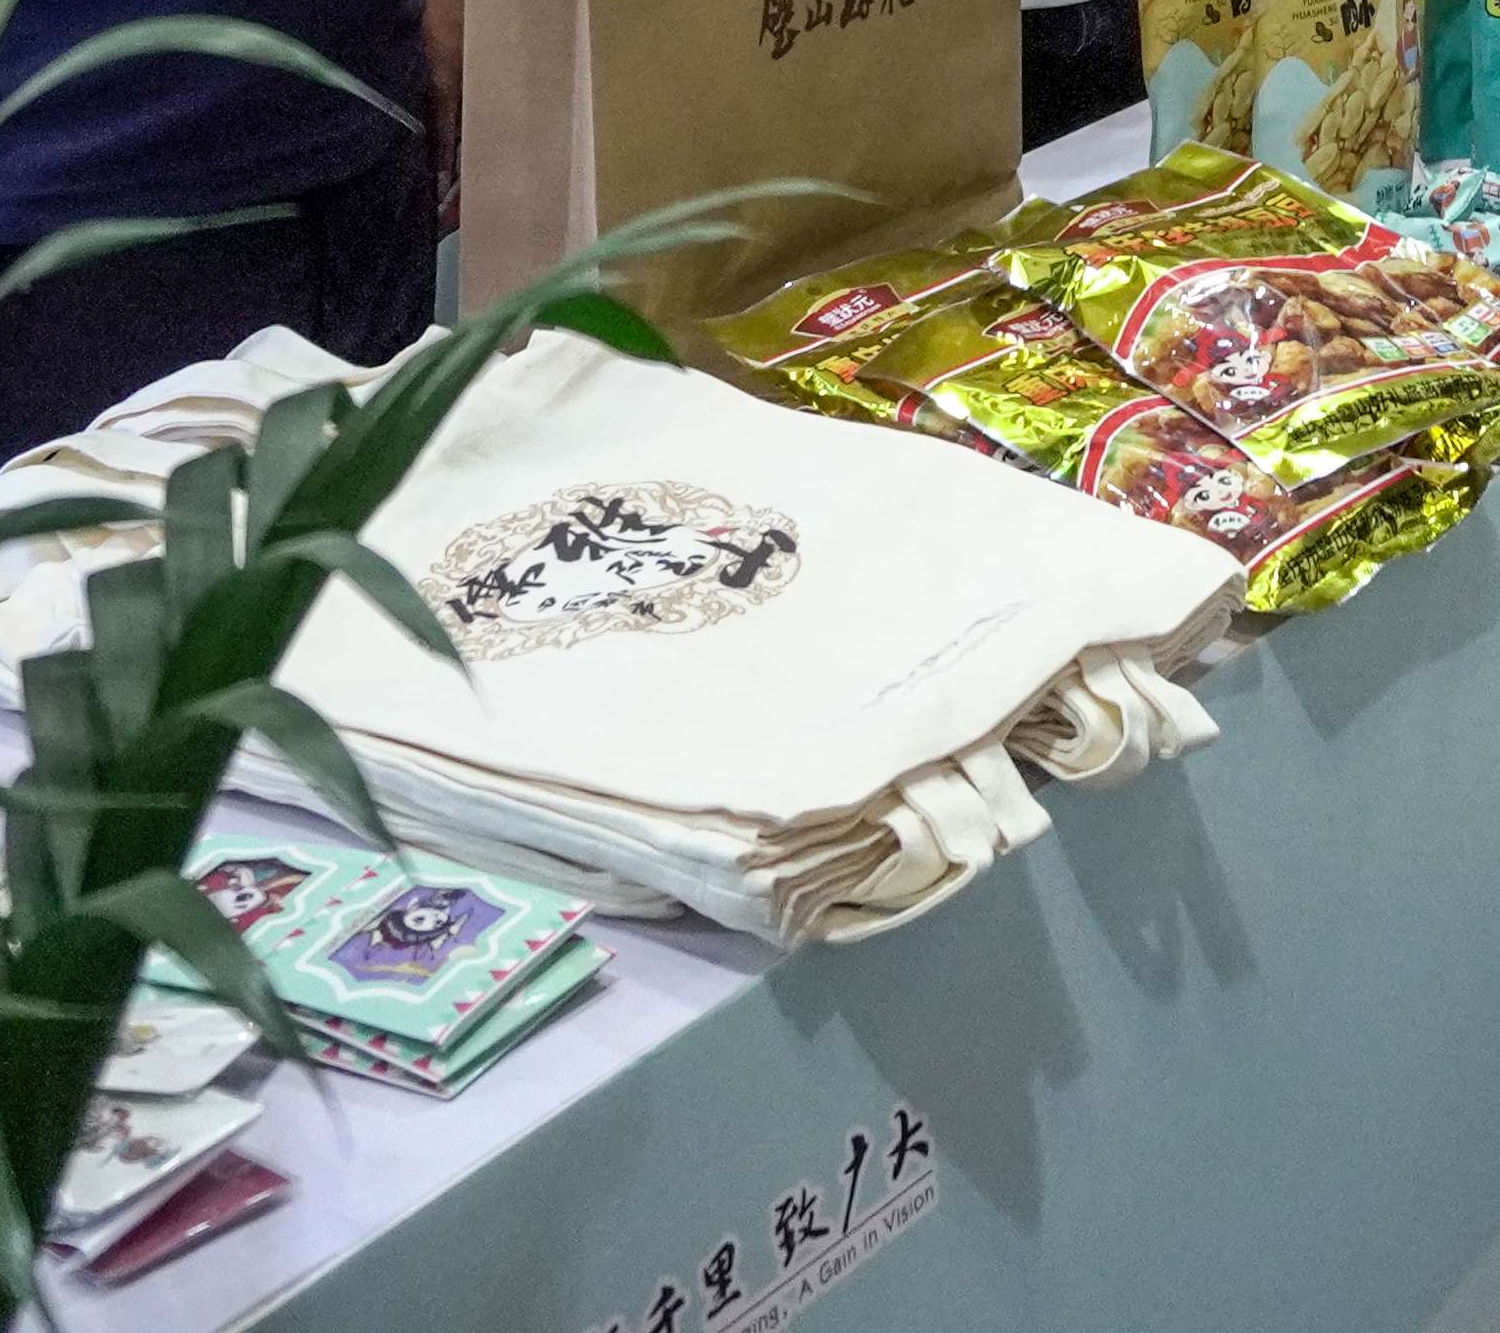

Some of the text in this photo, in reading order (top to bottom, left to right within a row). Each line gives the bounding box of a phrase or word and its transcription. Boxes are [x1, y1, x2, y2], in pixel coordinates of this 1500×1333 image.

[818, 1244, 858, 1286] Gain
[862, 1229, 879, 1252] in
[882, 1184, 935, 1234] Vision
